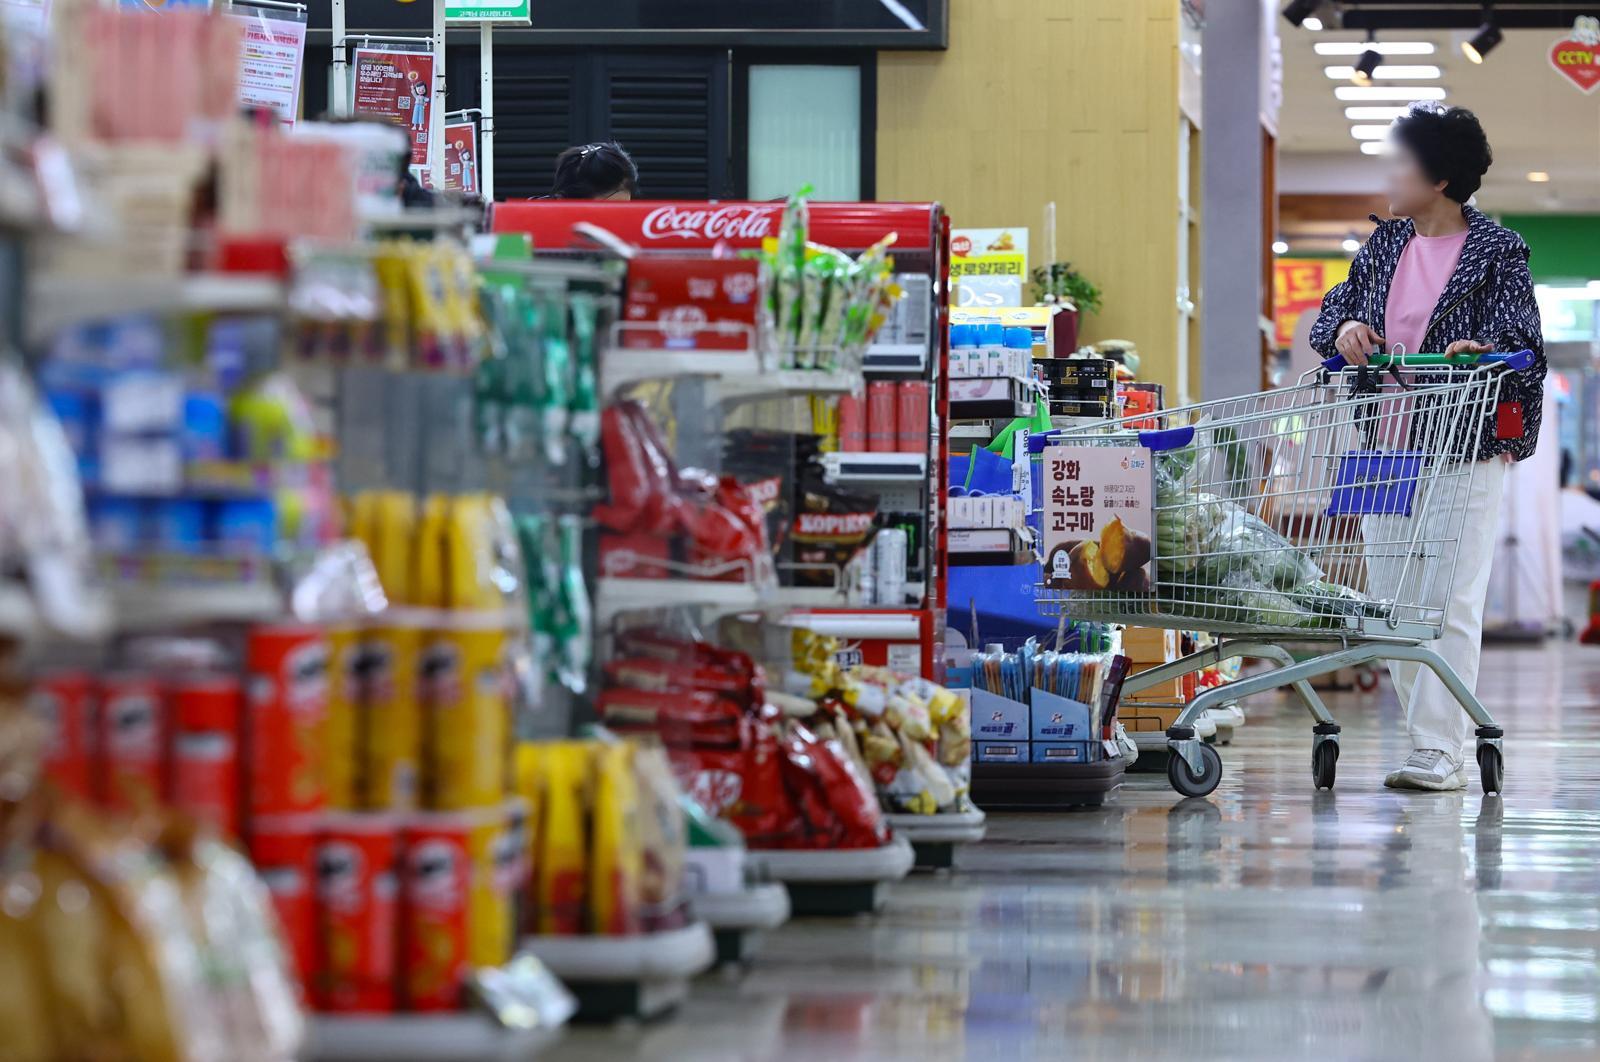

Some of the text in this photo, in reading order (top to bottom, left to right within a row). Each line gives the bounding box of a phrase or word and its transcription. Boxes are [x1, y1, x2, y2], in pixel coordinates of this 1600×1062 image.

[1558, 51, 1593, 64] CCTV
[642, 205, 778, 240] Coca-Cola
[1052, 460, 1081, 481] 강화
[1131, 460, 1145, 468] 강화군
[1052, 486, 1094, 507] 속노랑
[801, 513, 874, 533] KOPIKO
[1052, 511, 1094, 532] 고구마
